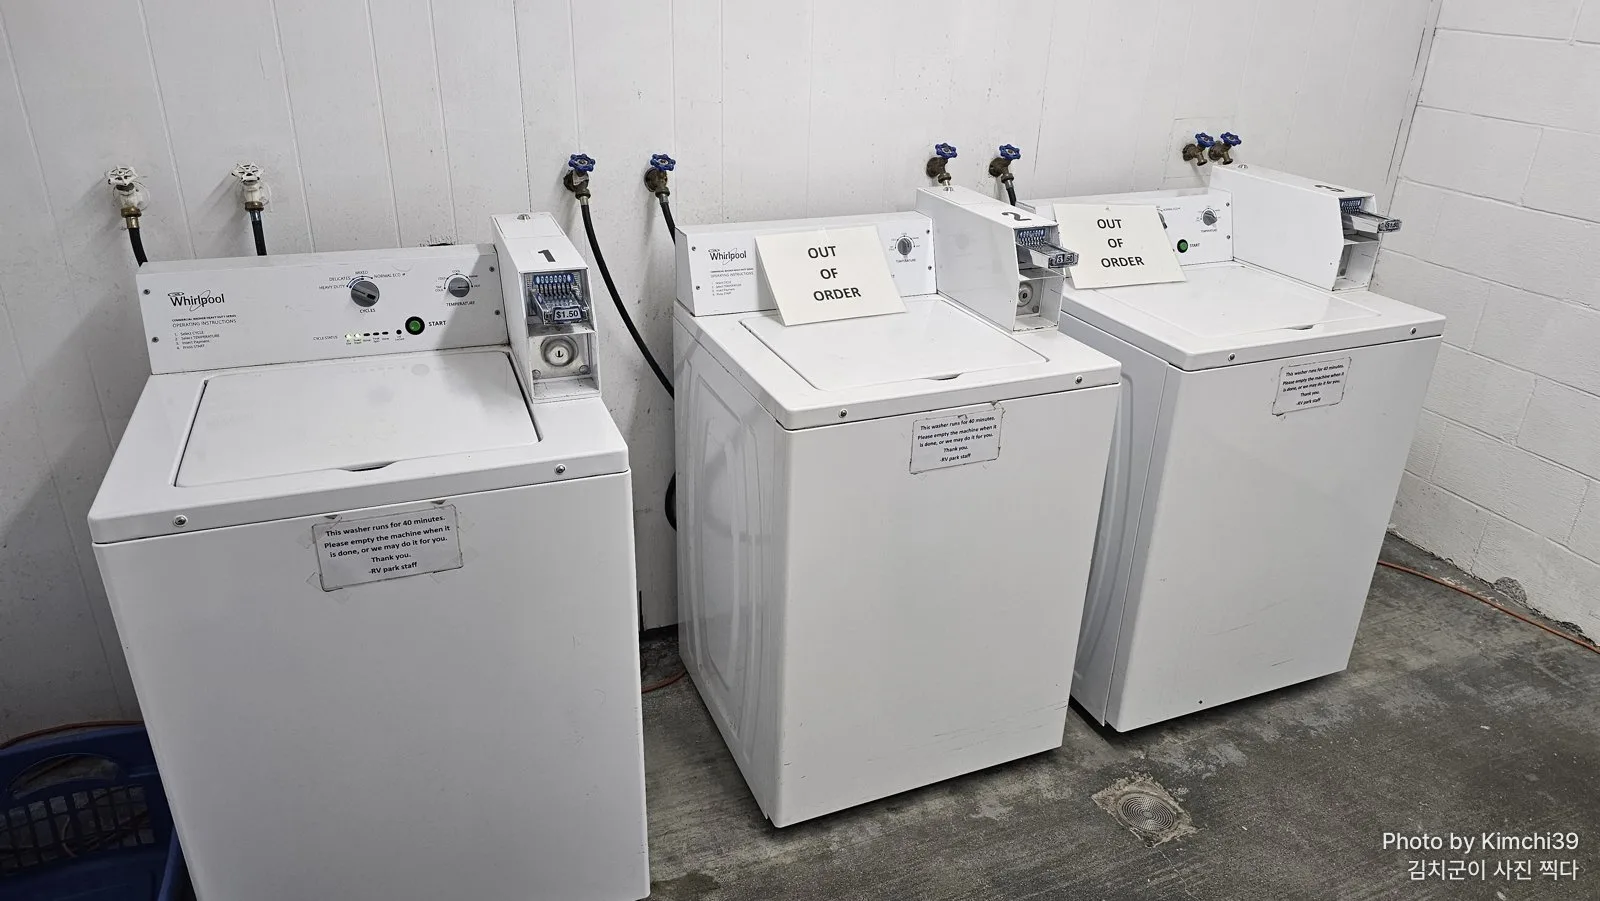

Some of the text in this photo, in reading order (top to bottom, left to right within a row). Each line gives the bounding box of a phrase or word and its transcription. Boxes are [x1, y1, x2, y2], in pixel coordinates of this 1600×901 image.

[1314, 184, 1345, 192] 3
[1002, 212, 1032, 221] 2
[1097, 219, 1122, 228] OUT
[1108, 238, 1124, 248] OF
[538, 250, 556, 262] 1
[710, 250, 746, 262] Whirlpool
[808, 246, 836, 258] OUT
[1100, 256, 1144, 268] ORDER
[820, 268, 838, 280] OF
[170, 293, 224, 307] Whirlpool
[813, 288, 862, 301] ORDER
[556, 310, 578, 318] $1.50
[414, 516, 445, 524] minutes.
[338, 548, 359, 556] done,
